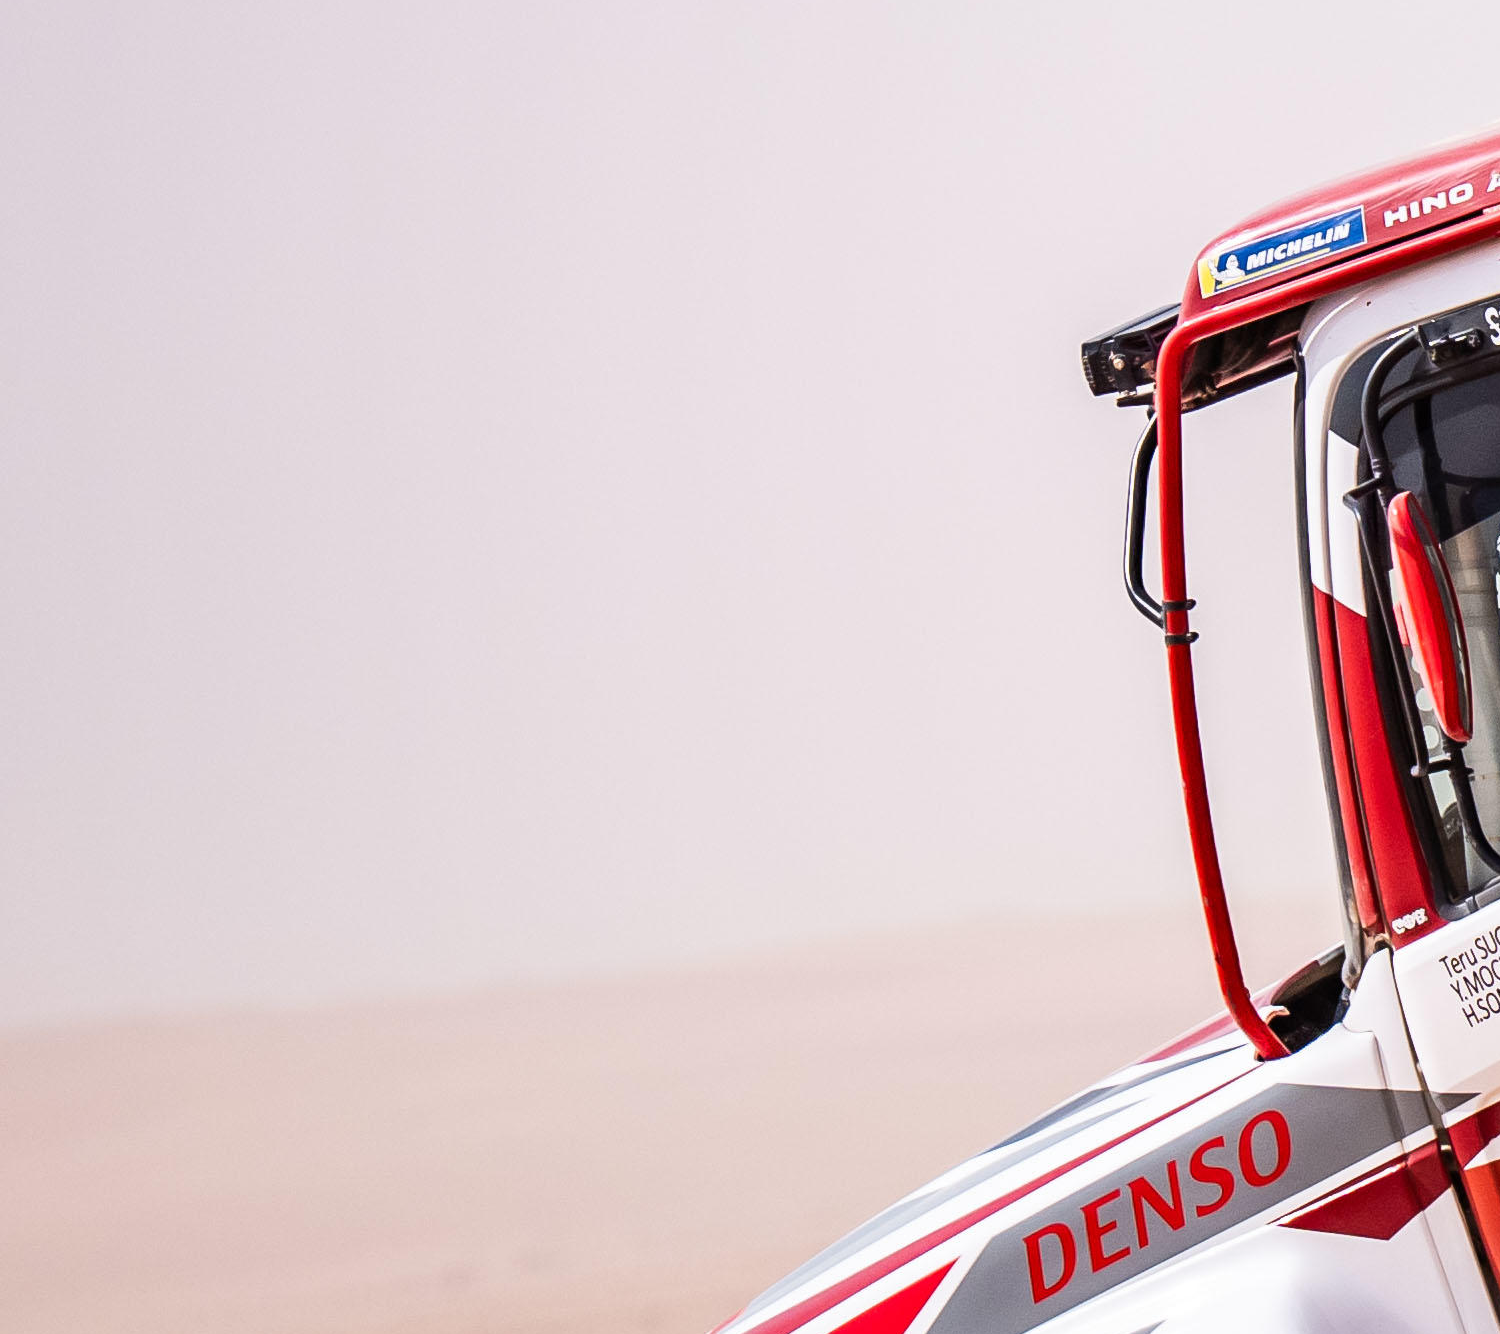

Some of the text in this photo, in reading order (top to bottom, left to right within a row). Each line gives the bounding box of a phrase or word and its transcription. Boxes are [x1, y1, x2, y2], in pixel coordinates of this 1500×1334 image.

[1383, 183, 1474, 228] HINO
[1246, 222, 1350, 269] MICHELIN
[1439, 947, 1476, 978] Teru
[1022, 1108, 1293, 1305] DENSO
